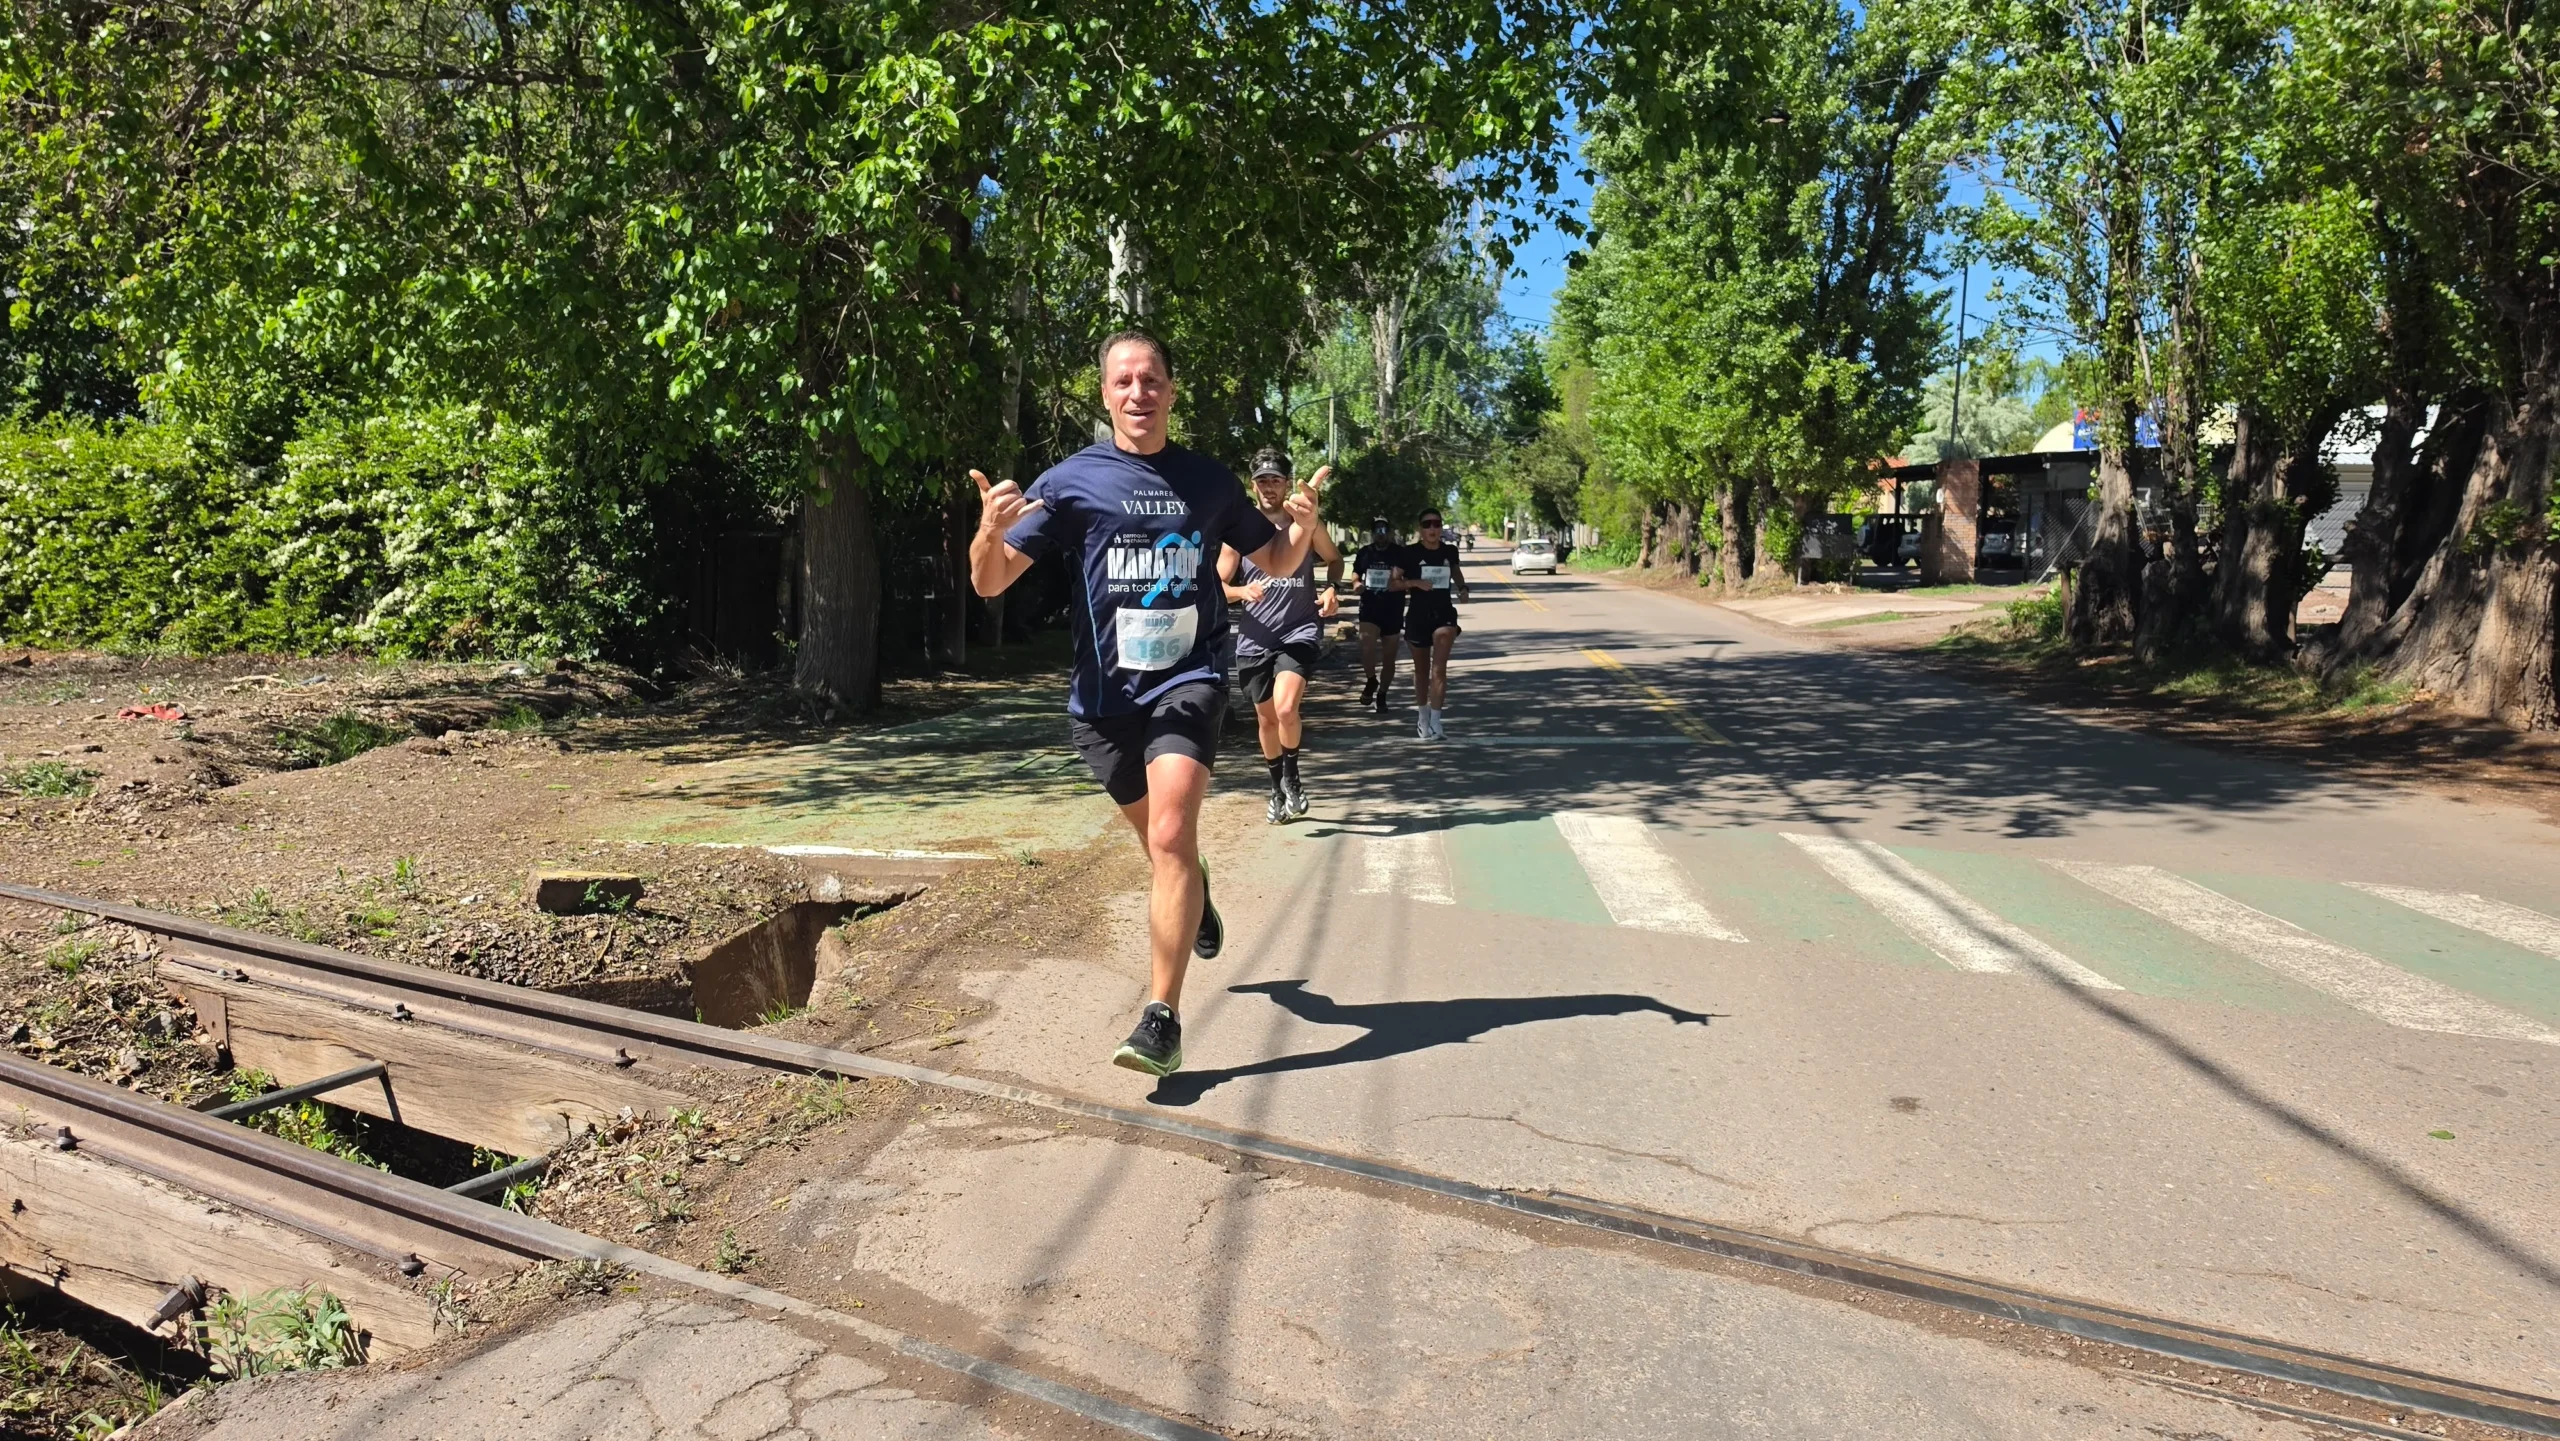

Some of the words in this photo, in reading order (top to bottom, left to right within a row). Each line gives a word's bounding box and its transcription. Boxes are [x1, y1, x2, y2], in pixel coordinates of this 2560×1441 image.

[1121, 500, 1186, 515] VALLEY
[1107, 584, 1130, 594] para
[1132, 582, 1157, 592] toda
[1160, 582, 1169, 592] la
[1170, 581, 1199, 592] familia
[1137, 638, 1180, 659] 186
